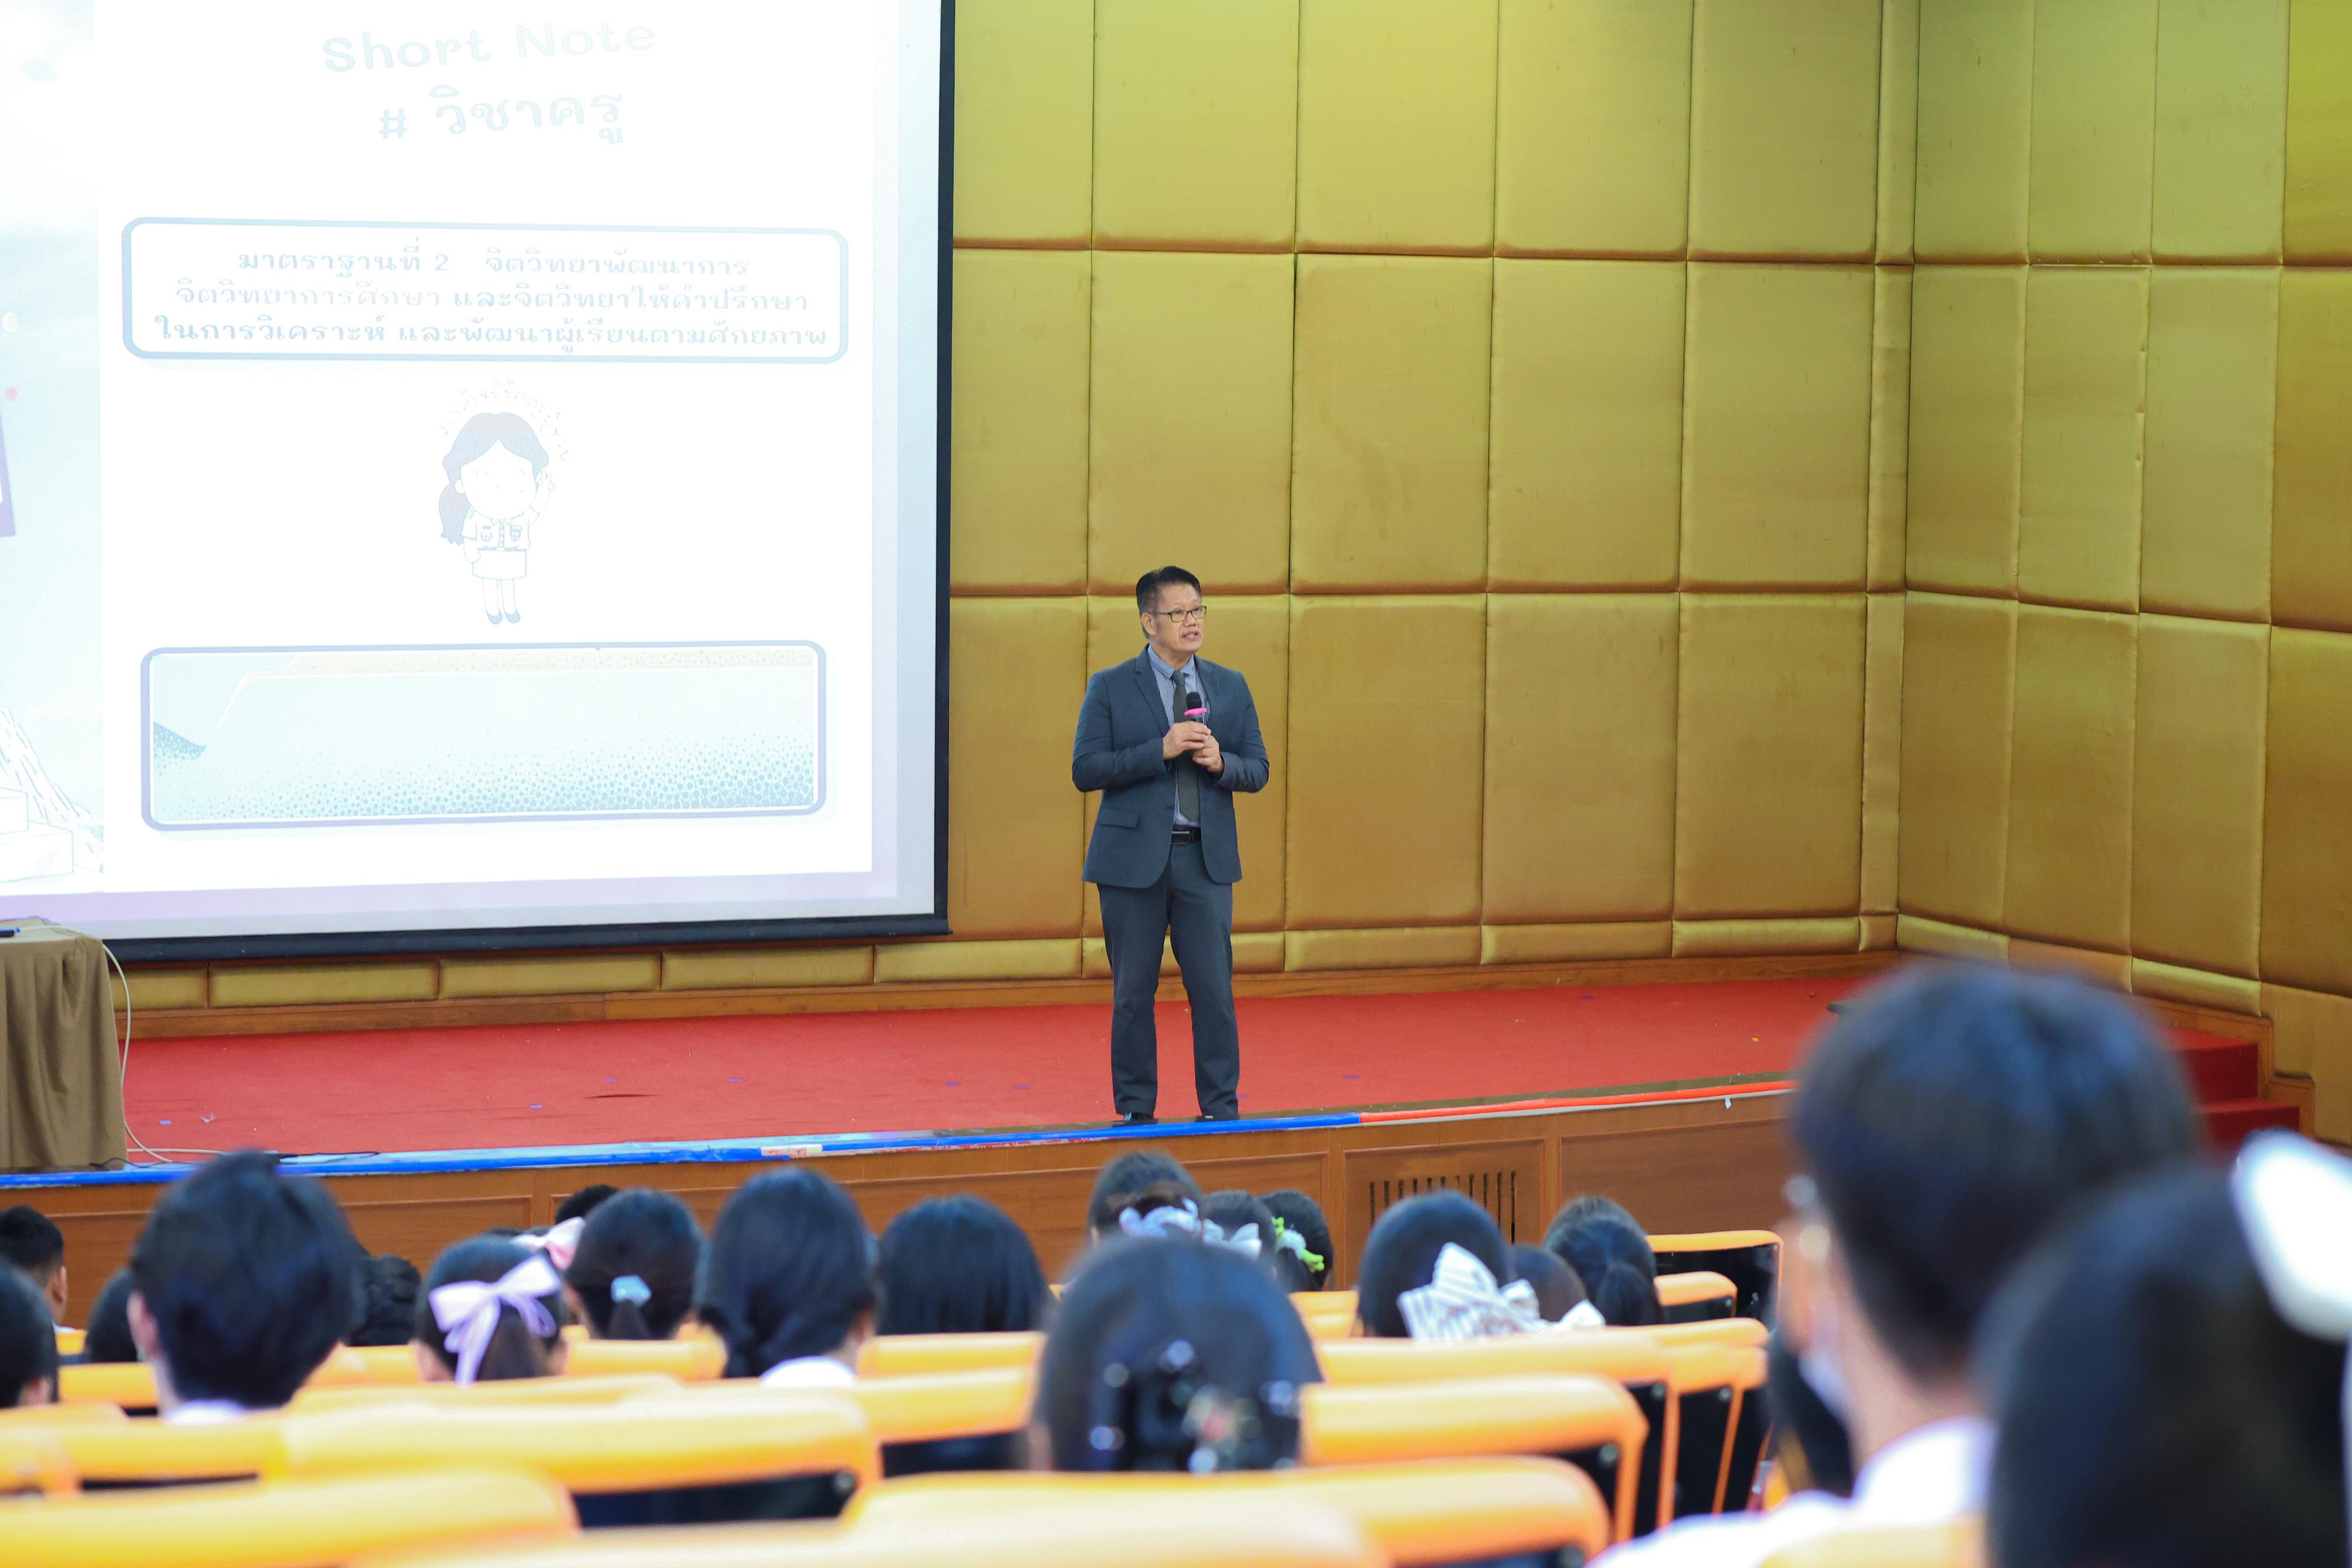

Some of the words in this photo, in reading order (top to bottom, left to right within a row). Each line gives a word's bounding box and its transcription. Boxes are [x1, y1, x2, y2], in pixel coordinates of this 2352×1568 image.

[322, 30, 490, 73] Short
[515, 20, 655, 58] Note
[378, 107, 408, 140] #
[429, 84, 624, 145] วิชาครู
[238, 236, 420, 277] มาตราฐานที่
[434, 254, 450, 272] 2
[485, 246, 750, 275] จิตวิทยาพัฒนาการ
[175, 277, 440, 306] จิตวิทยาการศึกษา
[153, 313, 387, 341] ในการวิเคราะห์
[397, 316, 827, 354] และพัฒนาผู้เรียนตามศักยภาพ
